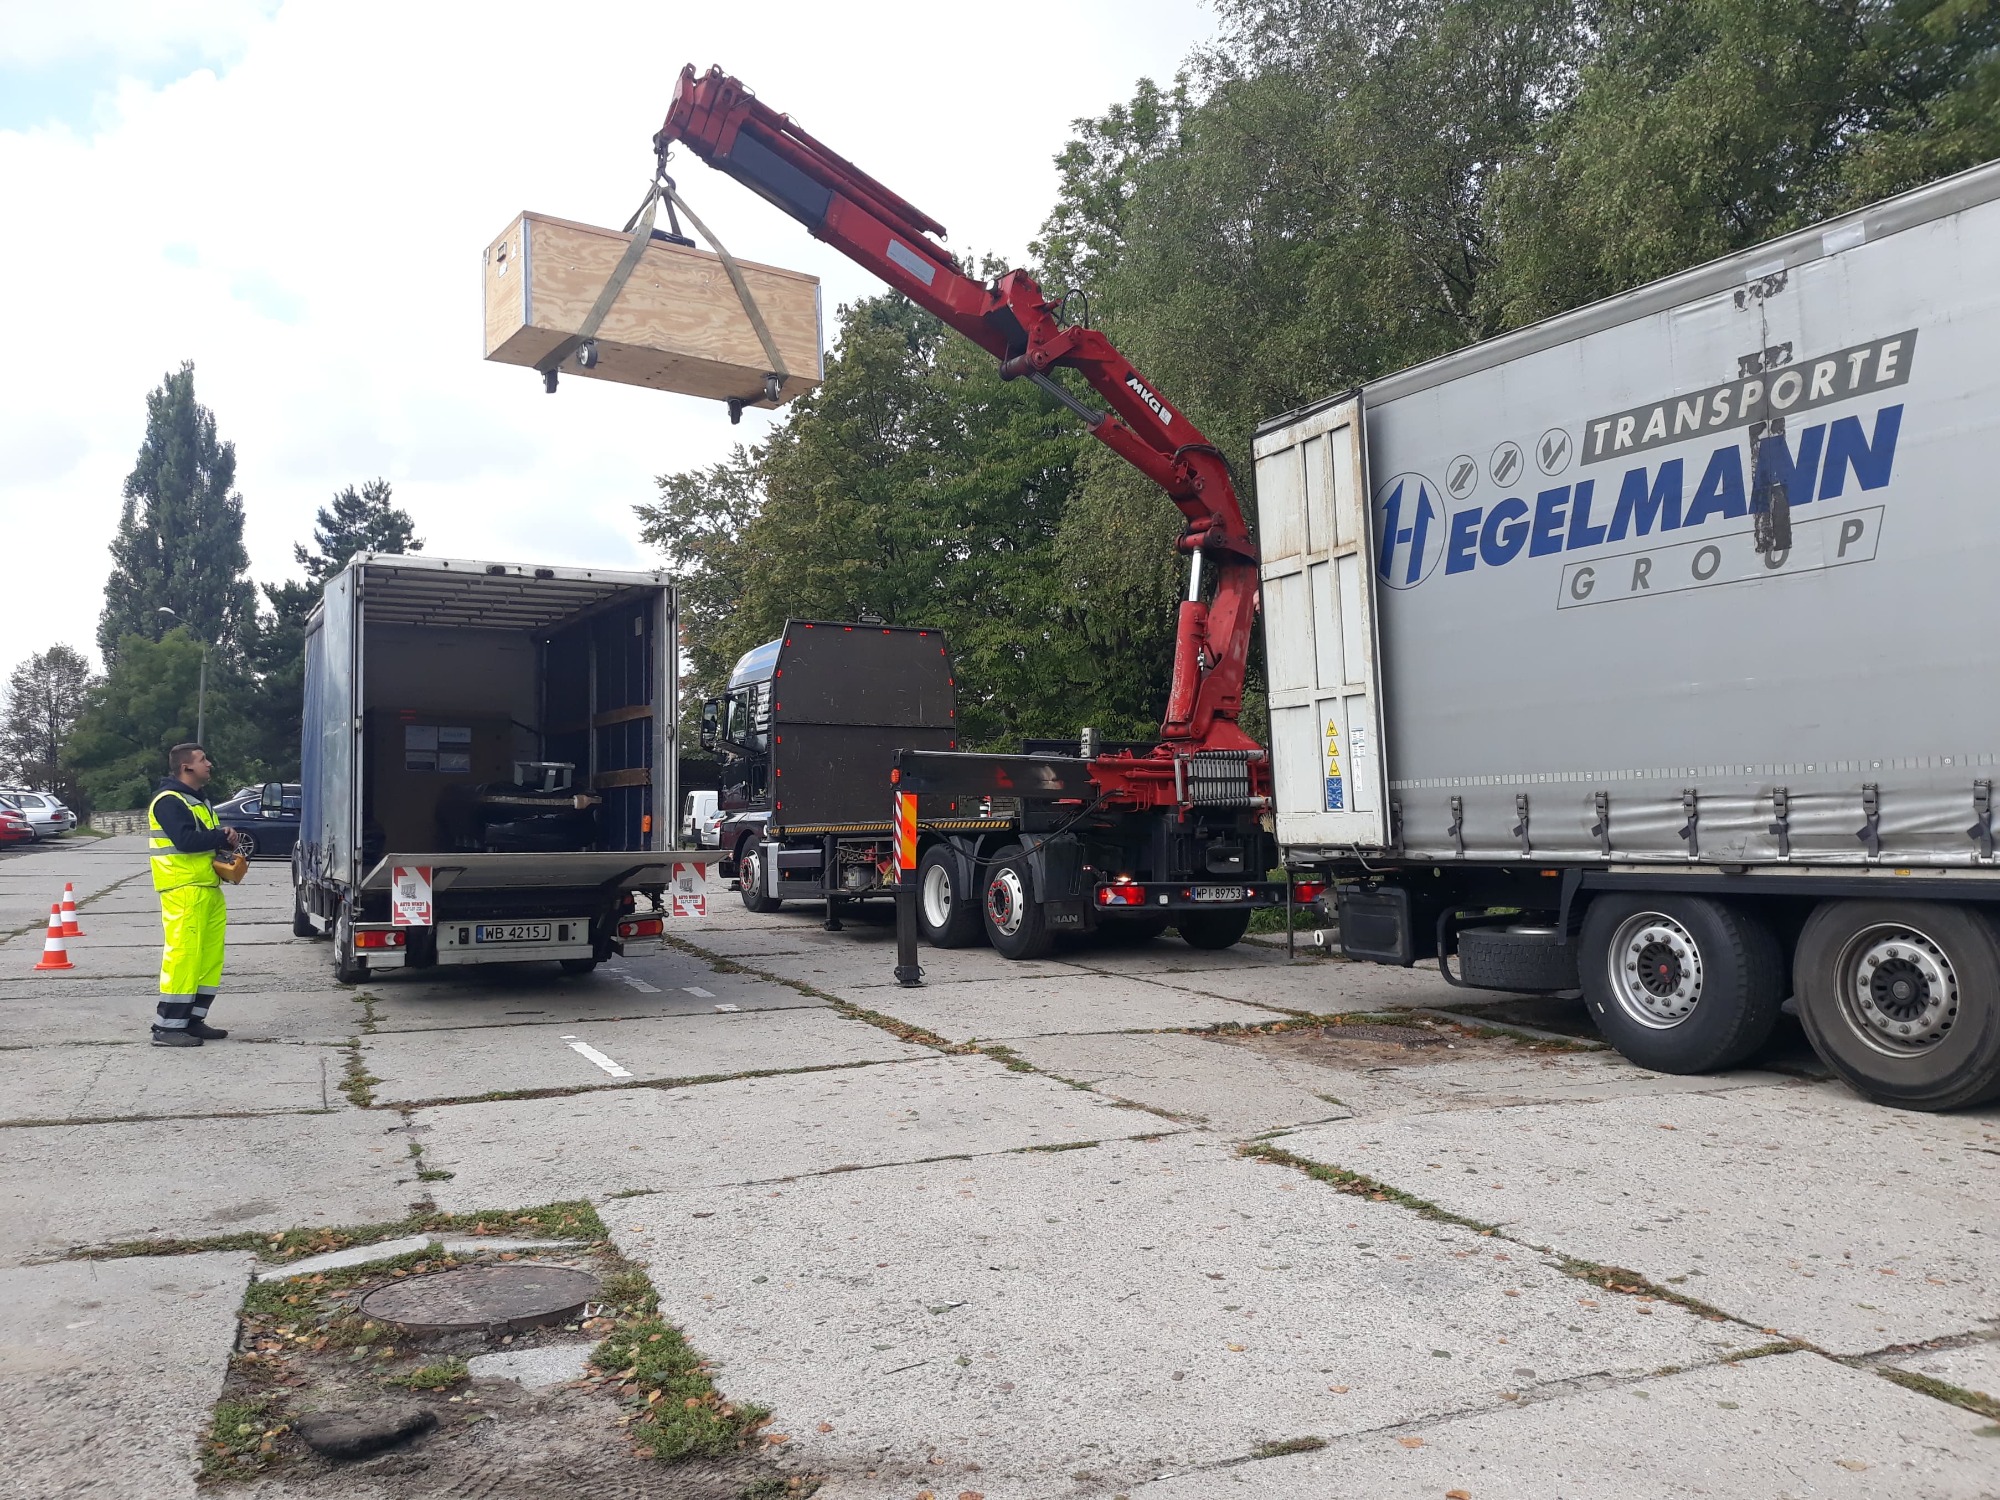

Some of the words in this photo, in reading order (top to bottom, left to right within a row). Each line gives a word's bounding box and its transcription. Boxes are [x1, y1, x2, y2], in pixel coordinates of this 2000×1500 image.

[1592, 339, 1902, 457] TRANSPORTE
[1376, 403, 1905, 586] HEGELMANN
[1215, 888, 1241, 899] 89753
[485, 927, 504, 940] WB
[509, 925, 547, 939] 4215J
